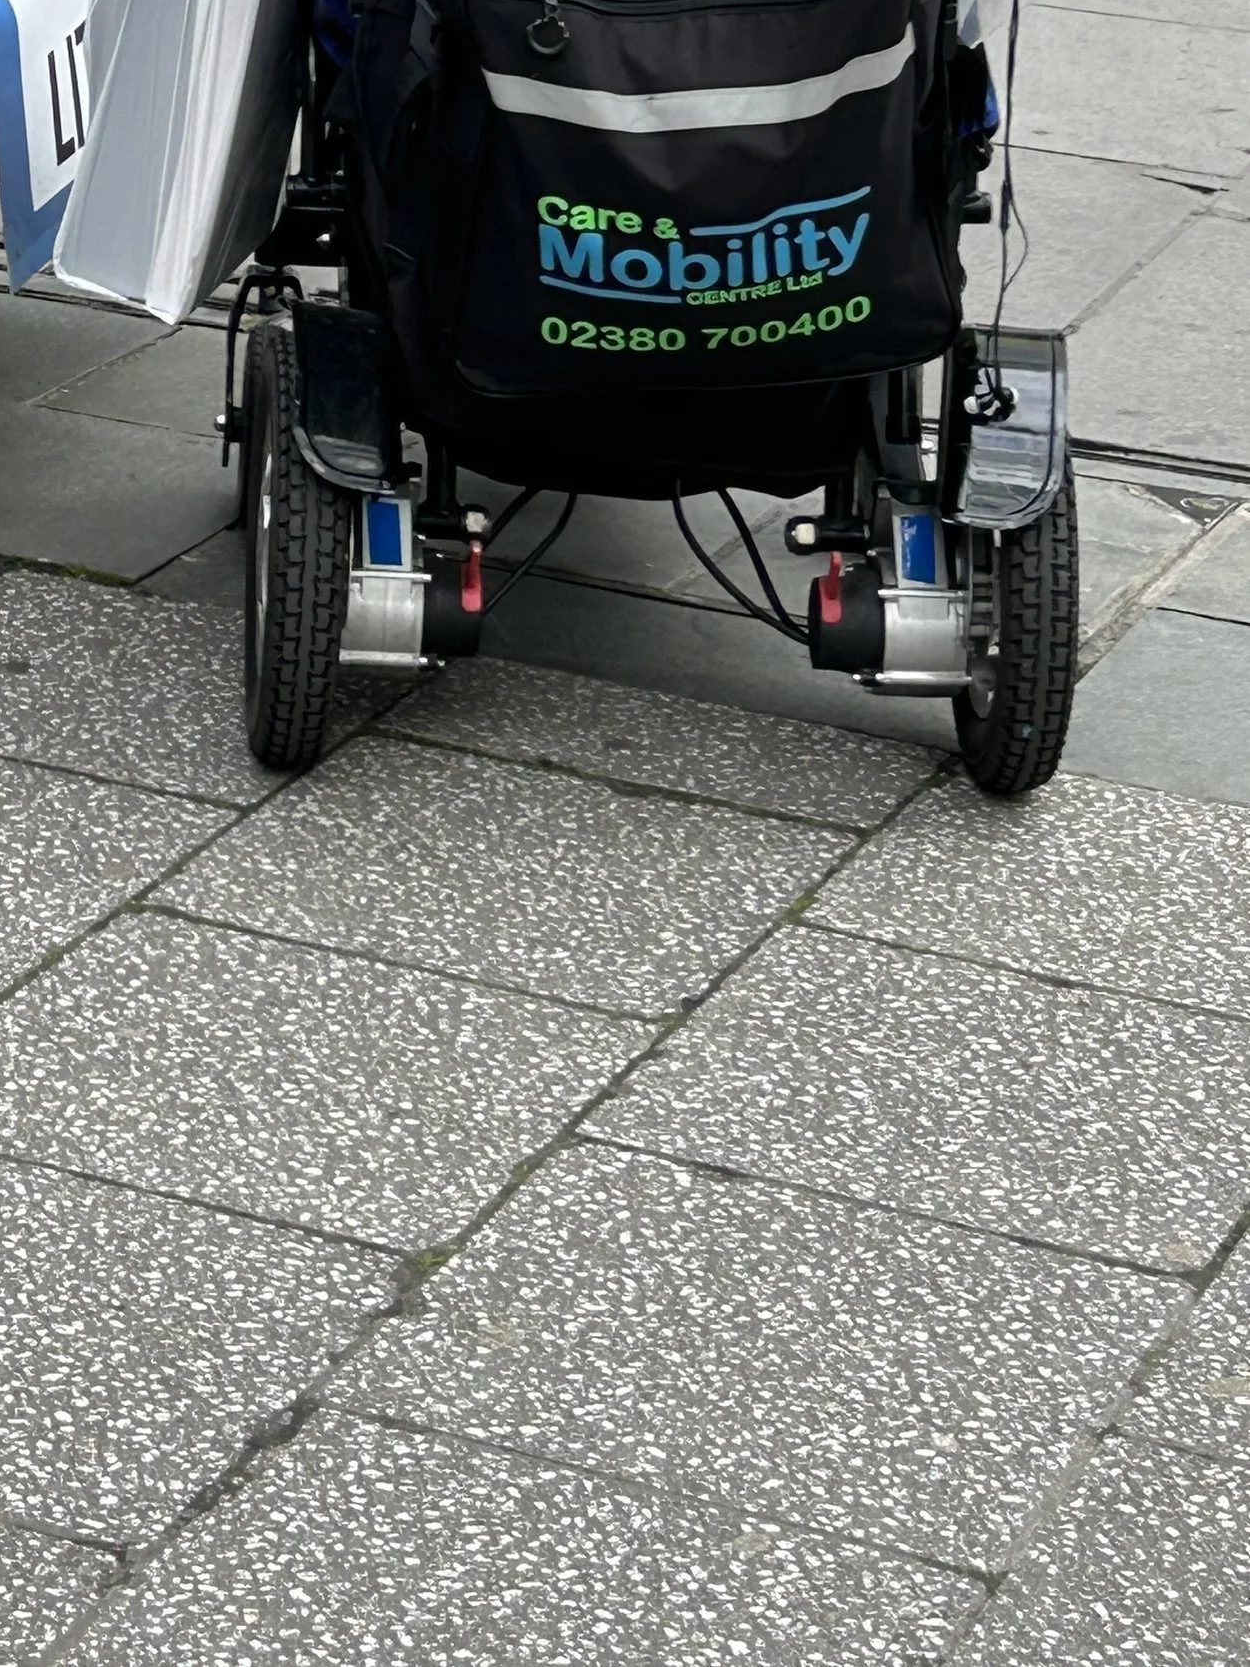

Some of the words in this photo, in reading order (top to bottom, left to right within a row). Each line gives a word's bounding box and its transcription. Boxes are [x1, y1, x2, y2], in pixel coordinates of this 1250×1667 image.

[538, 196, 642, 233] Care
[653, 218, 680, 239] &
[539, 213, 869, 291] Mobility
[686, 280, 781, 305] CENTRE
[541, 317, 686, 351] 02380
[701, 296, 871, 349] 700400
